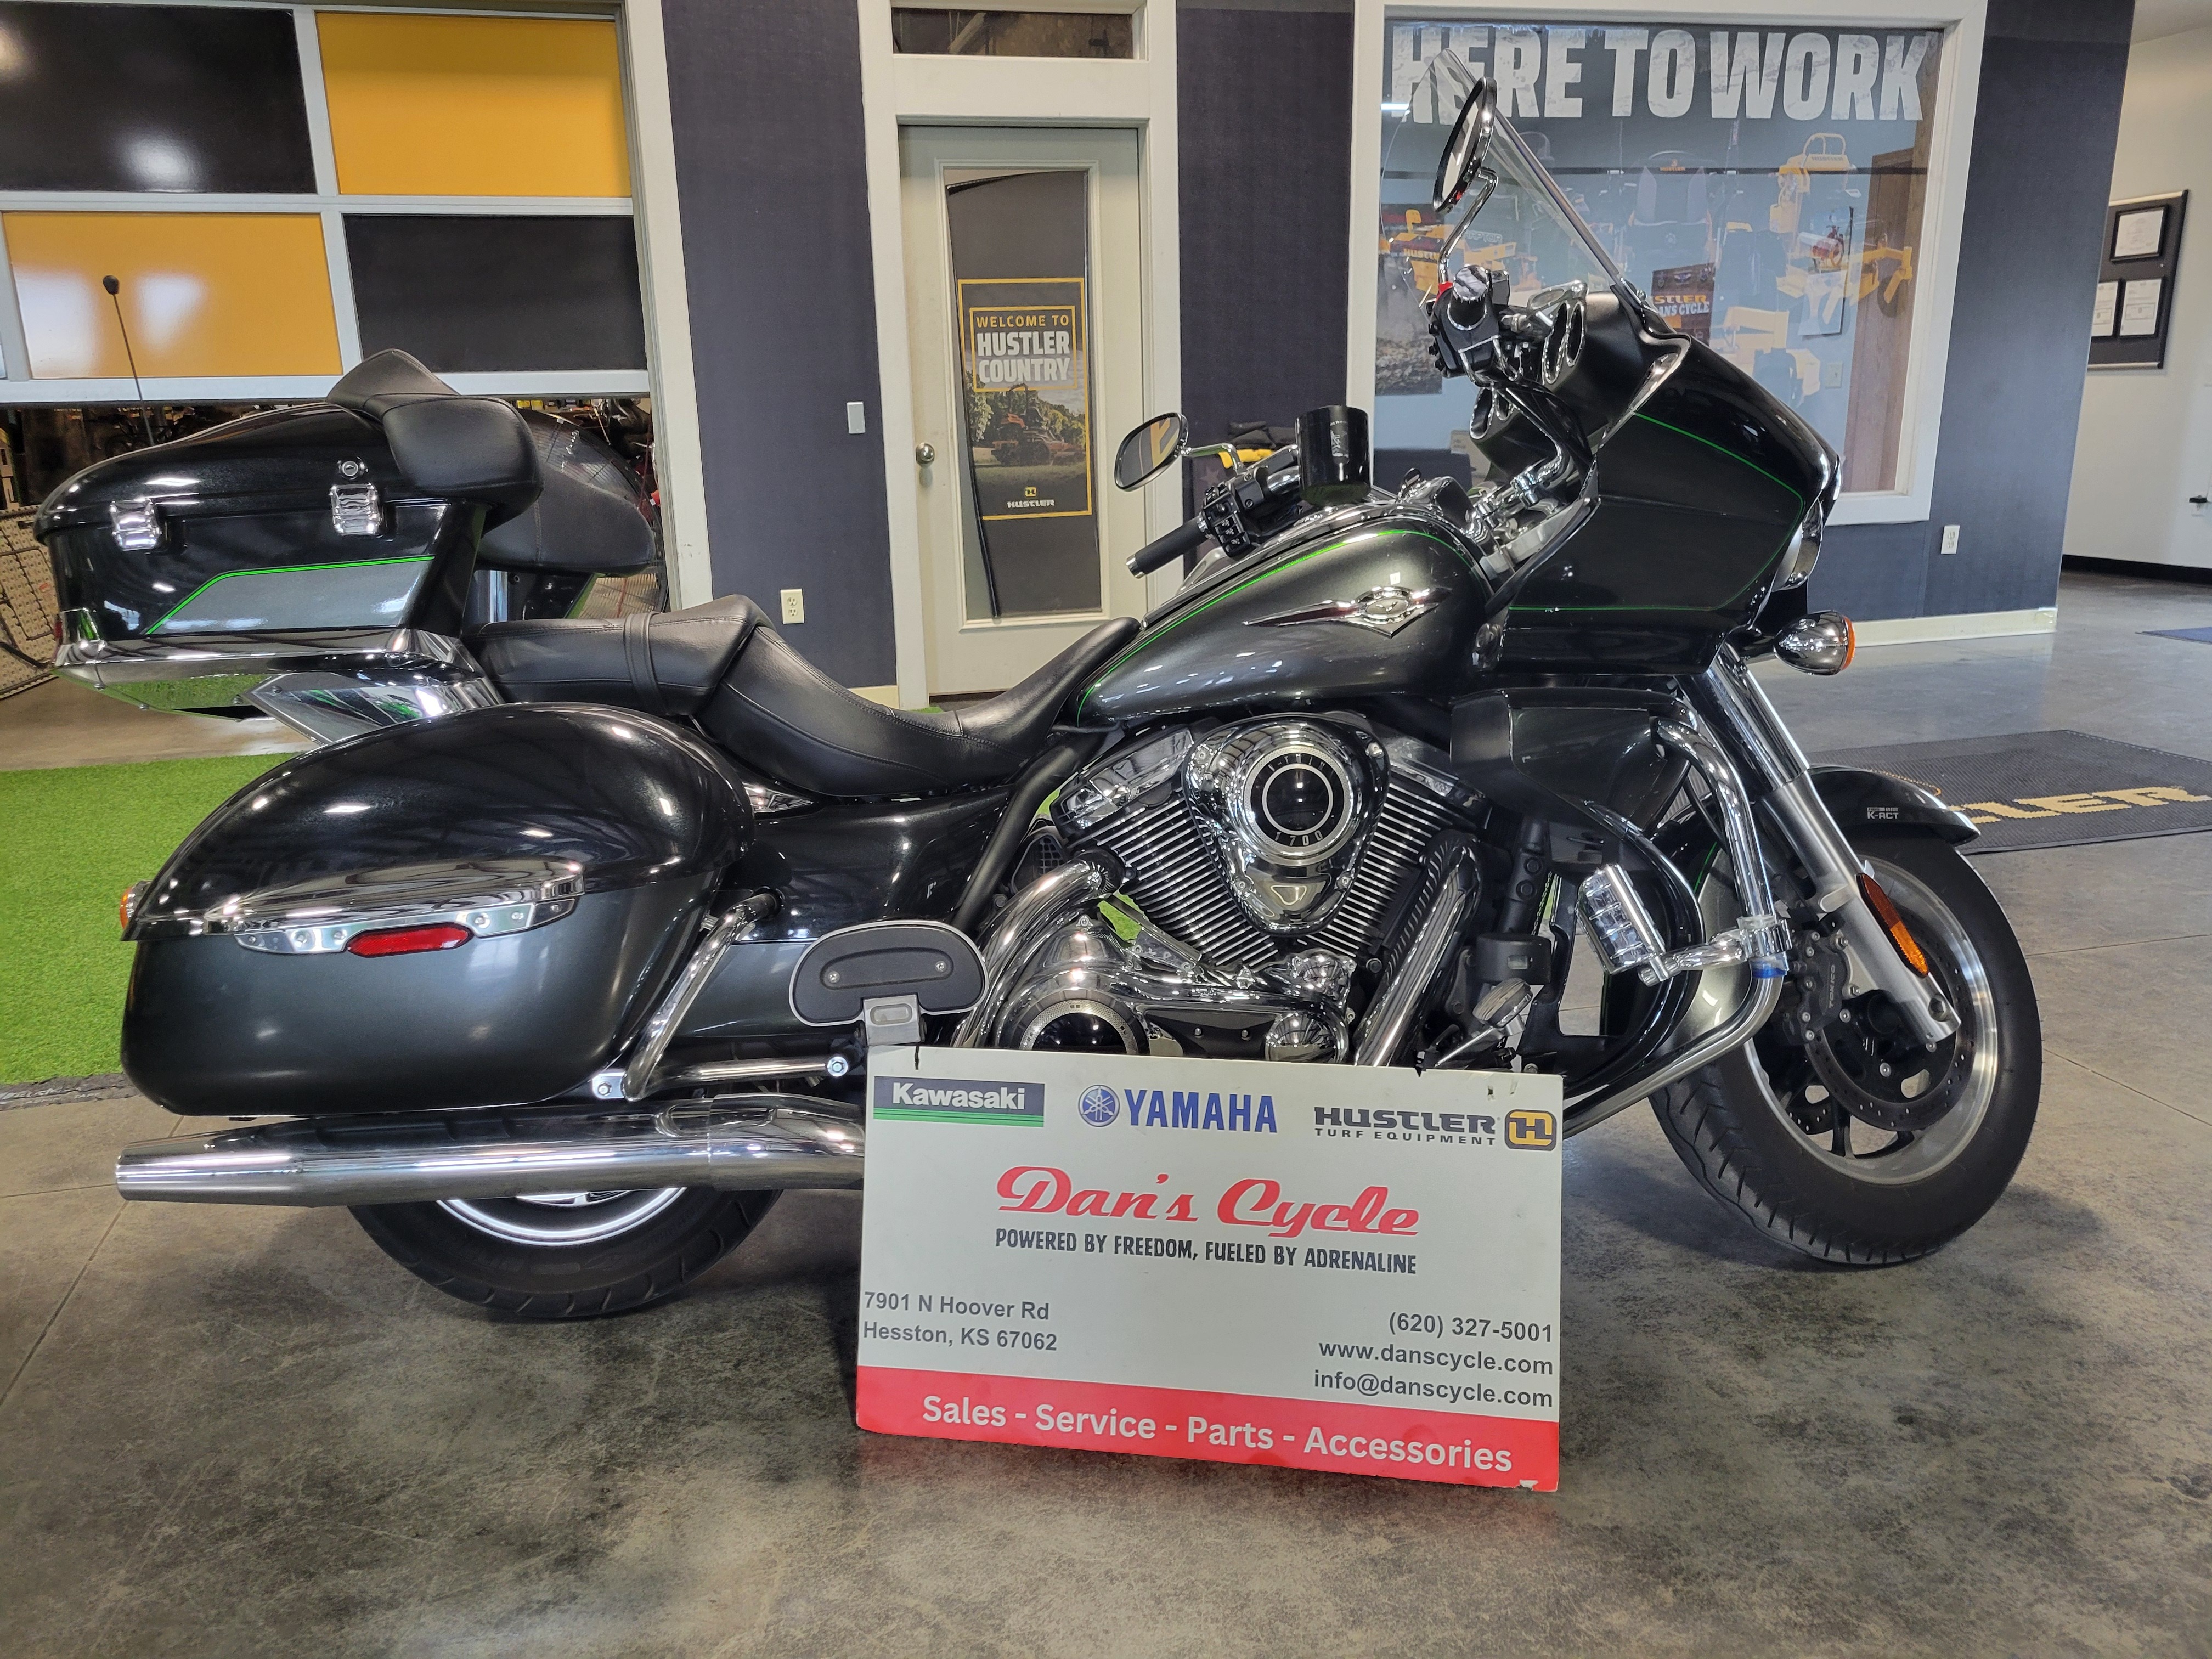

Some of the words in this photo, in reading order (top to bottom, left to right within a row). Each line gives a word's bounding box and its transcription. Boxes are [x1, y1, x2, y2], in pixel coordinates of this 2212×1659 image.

[1391, 26, 1586, 119] HERE
[1604, 29, 1700, 119] TO
[1709, 31, 1928, 121] WORK
[976, 315, 1046, 328] WELCOME
[1052, 314, 1069, 326] TO
[1658, 304, 1677, 317] ANS
[1679, 301, 1710, 315] CYCLE
[977, 331, 1070, 357] HUSTLER
[979, 358, 1070, 383] COUNTRY
[1007, 499, 1055, 508] HUSTLER
[1867, 811, 1899, 819] K-ACT
[1275, 830, 1323, 846] 1700
[892, 1082, 1025, 1110] Kawasaki
[1124, 1089, 1278, 1133] YAMAHA
[1314, 1107, 1496, 1135] HUSTLER
[1315, 1128, 1364, 1138] TURF
[1374, 1131, 1496, 1146] EQUIPMENT
[997, 1166, 1198, 1222] Dan's
[1217, 1178, 1419, 1238] Cycle
[996, 1228, 1076, 1252] POWERED
[1085, 1234, 1107, 1254] BY
[1114, 1235, 1198, 1261] FREEDOM,
[1206, 1241, 1265, 1264] FUELED
[1274, 1245, 1297, 1266] BY
[1305, 1248, 1417, 1274] ADRENALINE
[864, 1291, 910, 1311] 7901
[918, 1295, 933, 1312] N
[940, 1296, 1015, 1318] Hoover
[1021, 1302, 1049, 1320] Rd
[864, 1321, 953, 1346] Hesston,
[961, 1328, 989, 1346] KS
[997, 1330, 1057, 1351] 67062
[1389, 1312, 1444, 1338] (620)
[1452, 1318, 1552, 1342] 327-5001
[1319, 1341, 1553, 1375] www.danscycle.com
[1314, 1370, 1553, 1407] info@danscycle.com
[923, 1395, 1006, 1427] Sales
[1036, 1404, 1155, 1439] Service
[1188, 1415, 1273, 1449] Parts
[1304, 1427, 1513, 1472] Accessories
